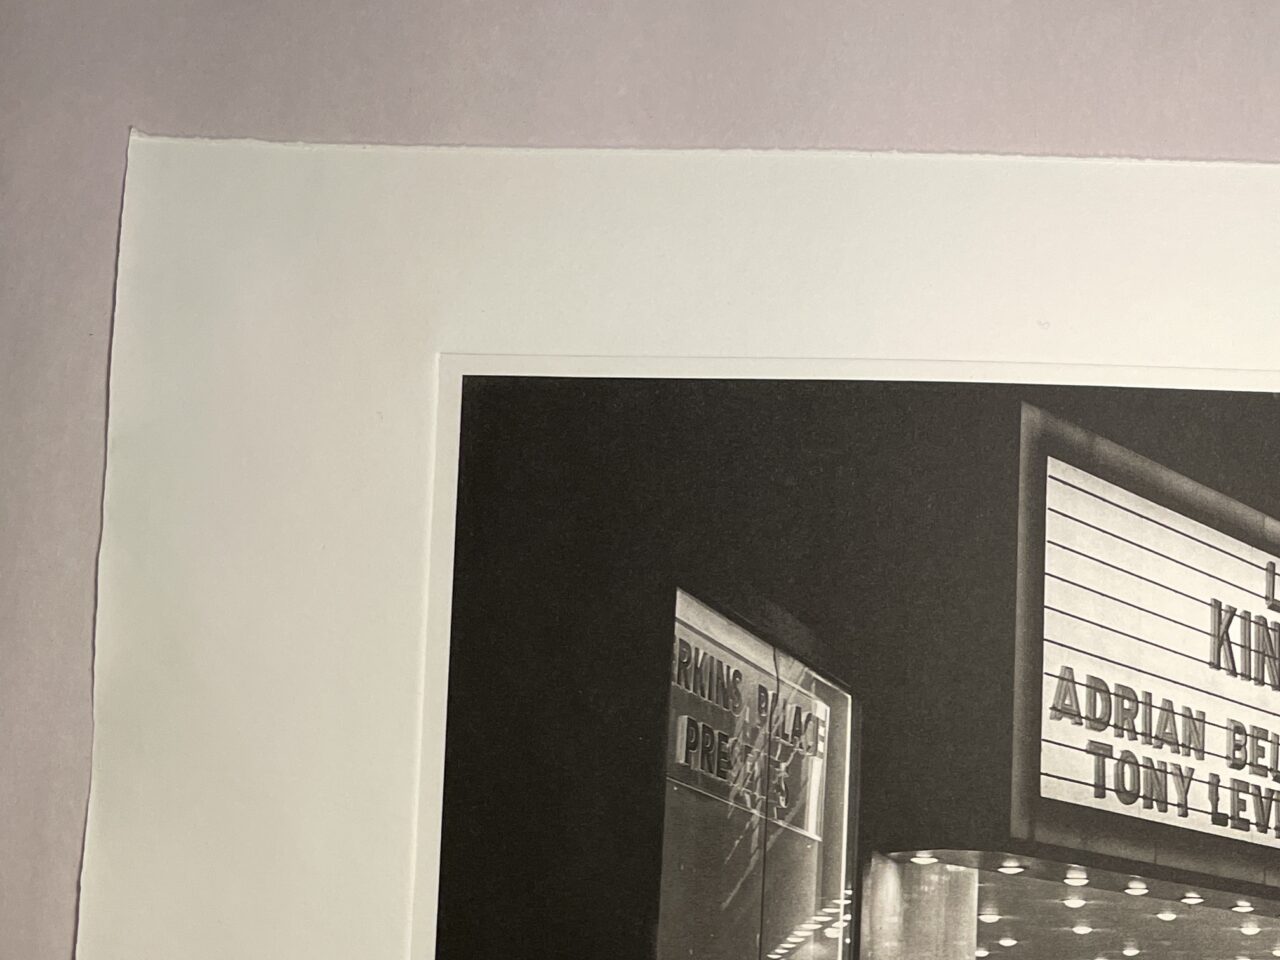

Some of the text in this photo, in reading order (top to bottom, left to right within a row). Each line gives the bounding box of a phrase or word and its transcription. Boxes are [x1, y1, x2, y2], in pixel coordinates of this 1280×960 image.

[674, 637, 743, 717] RKINS
[1049, 666, 1206, 761] ADRIAN
[1086, 740, 1194, 818] TONY
